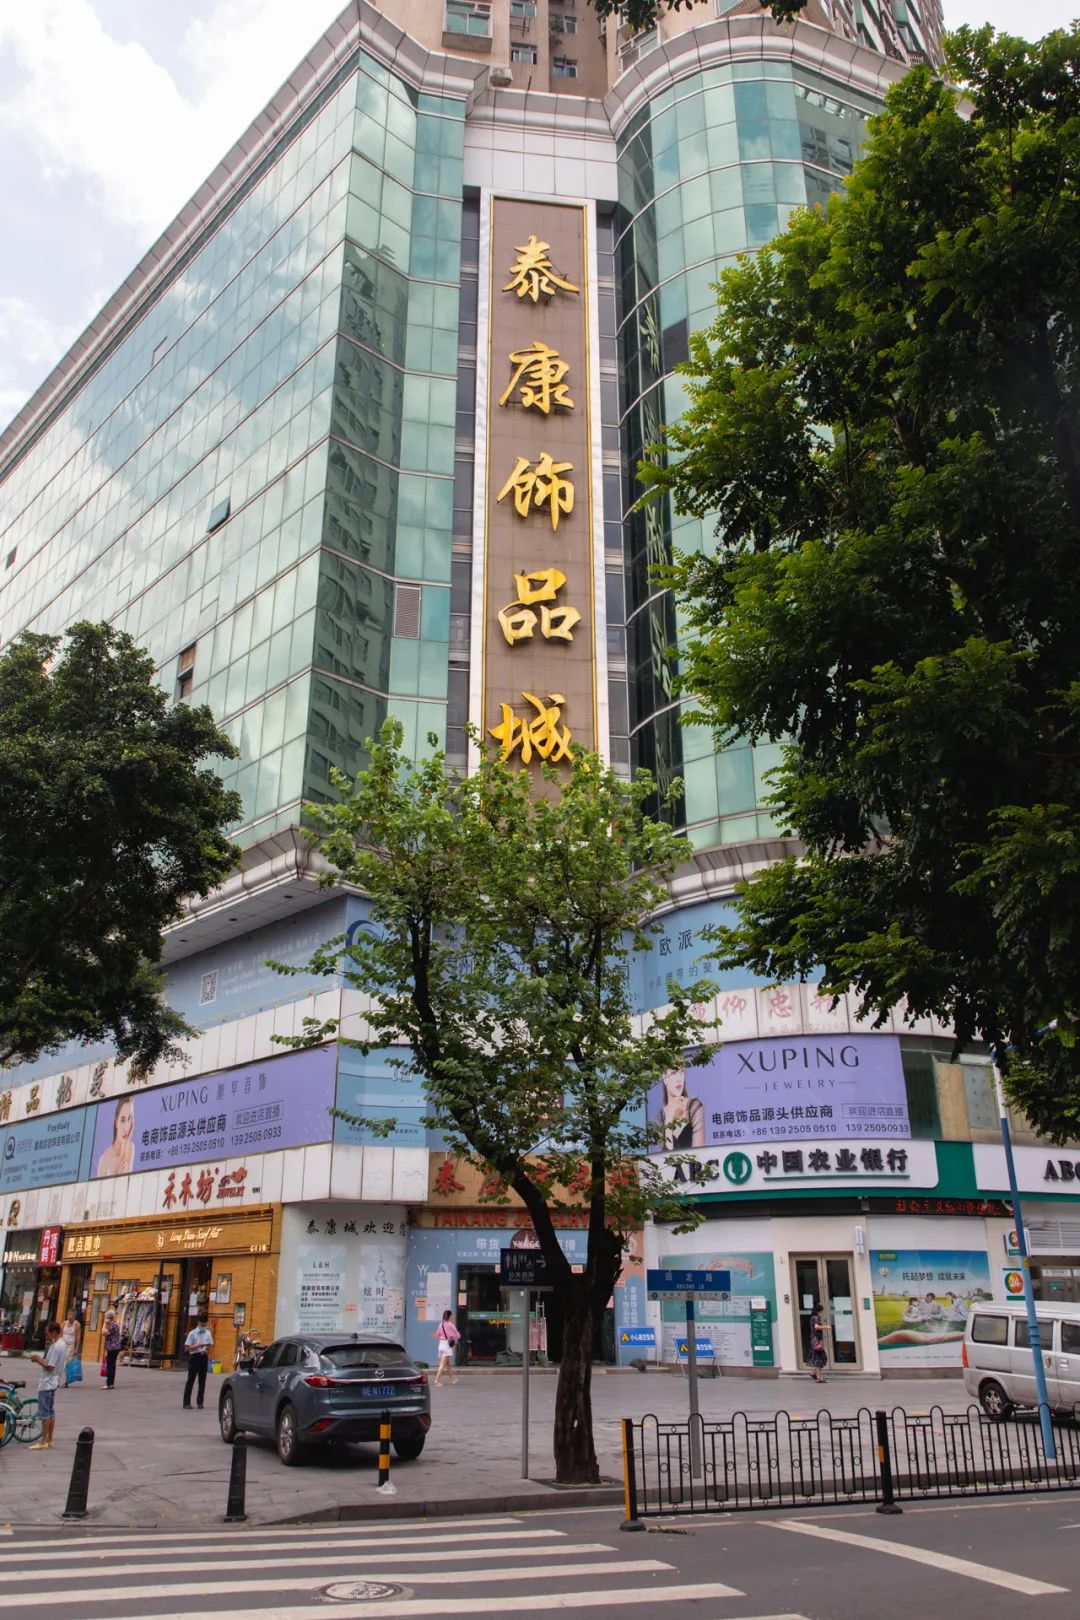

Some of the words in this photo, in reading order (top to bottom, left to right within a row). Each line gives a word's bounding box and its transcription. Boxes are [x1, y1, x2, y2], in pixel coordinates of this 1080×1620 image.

[489, 235, 580, 764] 泰康饰品城
[737, 1045, 860, 1074] XUPING
[764, 1079, 836, 1092] JEWELRY
[161, 1086, 208, 1112] XUPING
[712, 1105, 833, 1125] 电商饰品源头供应商
[849, 1106, 904, 1117] 欢迎进店直播
[141, 1113, 227, 1146] 电商饰品源头供应商
[756, 1147, 909, 1175] 中国农业银行
[432, 1209, 507, 1228] TAIKANG
[514, 1209, 589, 1228] JEELRY
[902, 1272, 934, 1281] 托起梦想
[937, 1272, 966, 1281] 成就未来
